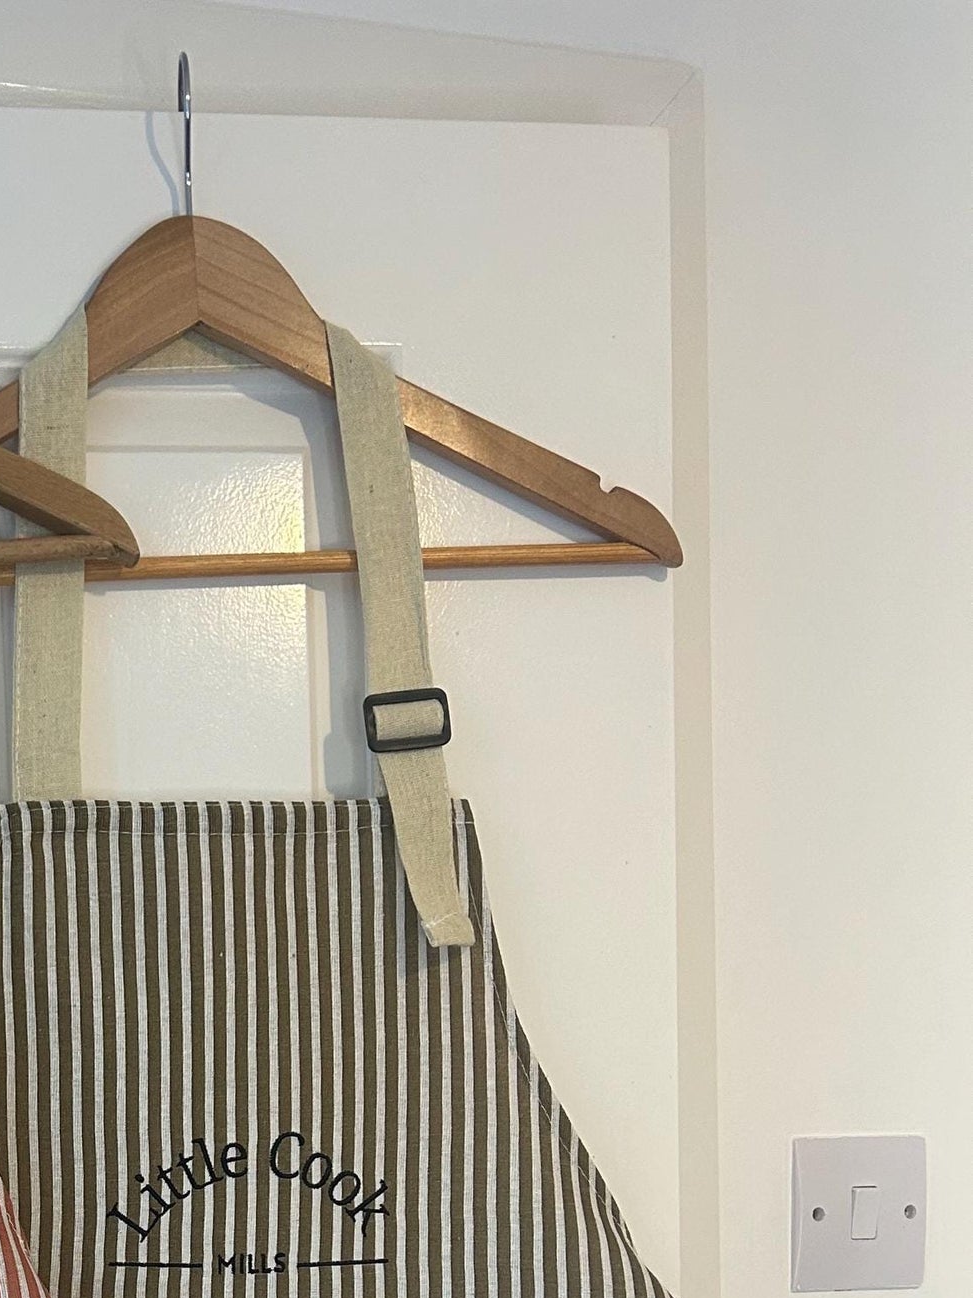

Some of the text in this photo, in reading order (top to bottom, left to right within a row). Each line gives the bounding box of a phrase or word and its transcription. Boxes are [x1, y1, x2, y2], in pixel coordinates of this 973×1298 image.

[107, 1131, 389, 1243] Little Cook
[217, 1253, 286, 1275] MILLS
